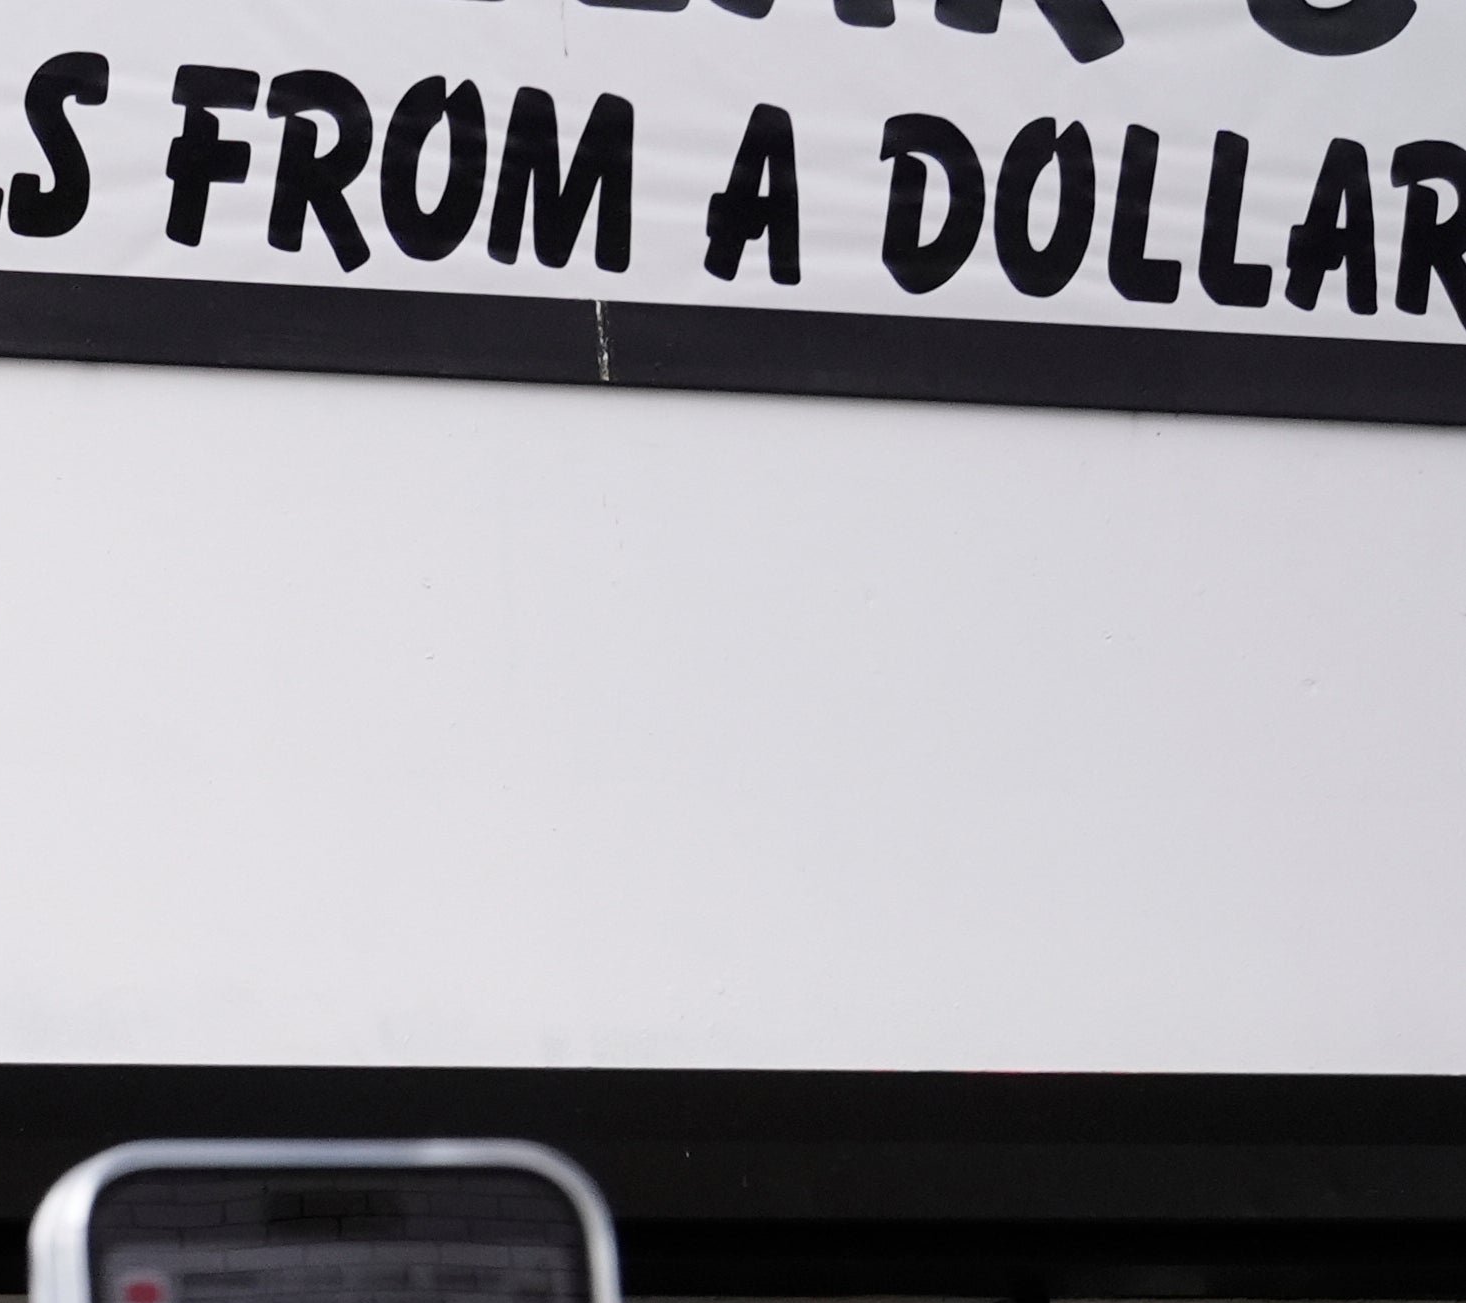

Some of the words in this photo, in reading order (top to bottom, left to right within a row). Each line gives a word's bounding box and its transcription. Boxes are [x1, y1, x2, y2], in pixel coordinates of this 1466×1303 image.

[165, 61, 635, 274] FROM
[705, 103, 801, 287] A
[880, 112, 1466, 326] DOLLAR
